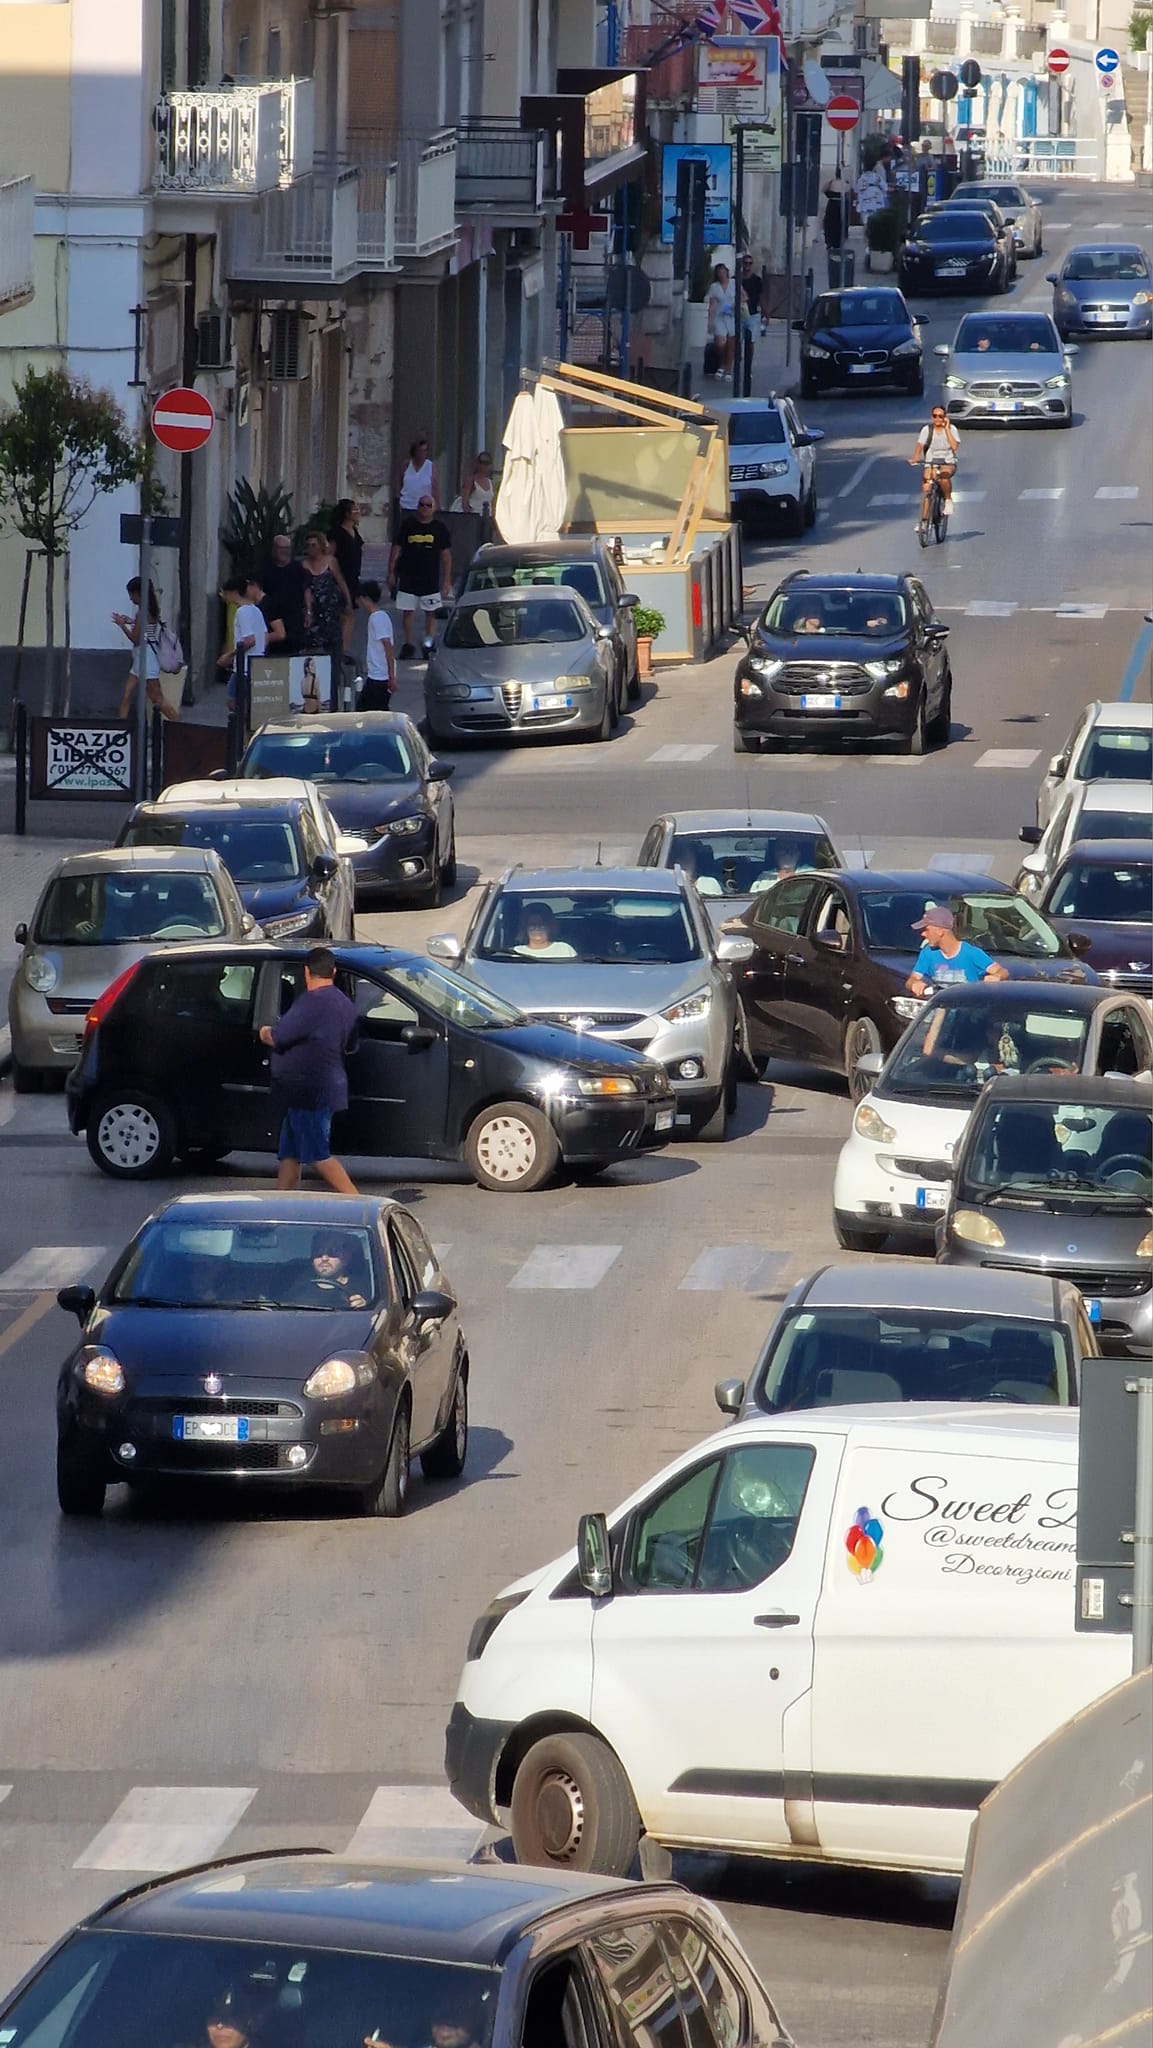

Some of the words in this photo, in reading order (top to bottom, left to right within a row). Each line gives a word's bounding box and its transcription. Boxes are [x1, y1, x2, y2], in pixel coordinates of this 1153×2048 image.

[51, 732, 128, 747] SPAZIO
[53, 749, 124, 763] LIBERO
[881, 1475, 1032, 1524] Sweet
[1038, 1488, 1078, 1529] D
[924, 1525, 1077, 1553] @sweetdream
[941, 1553, 1072, 1585] Decorazioni
